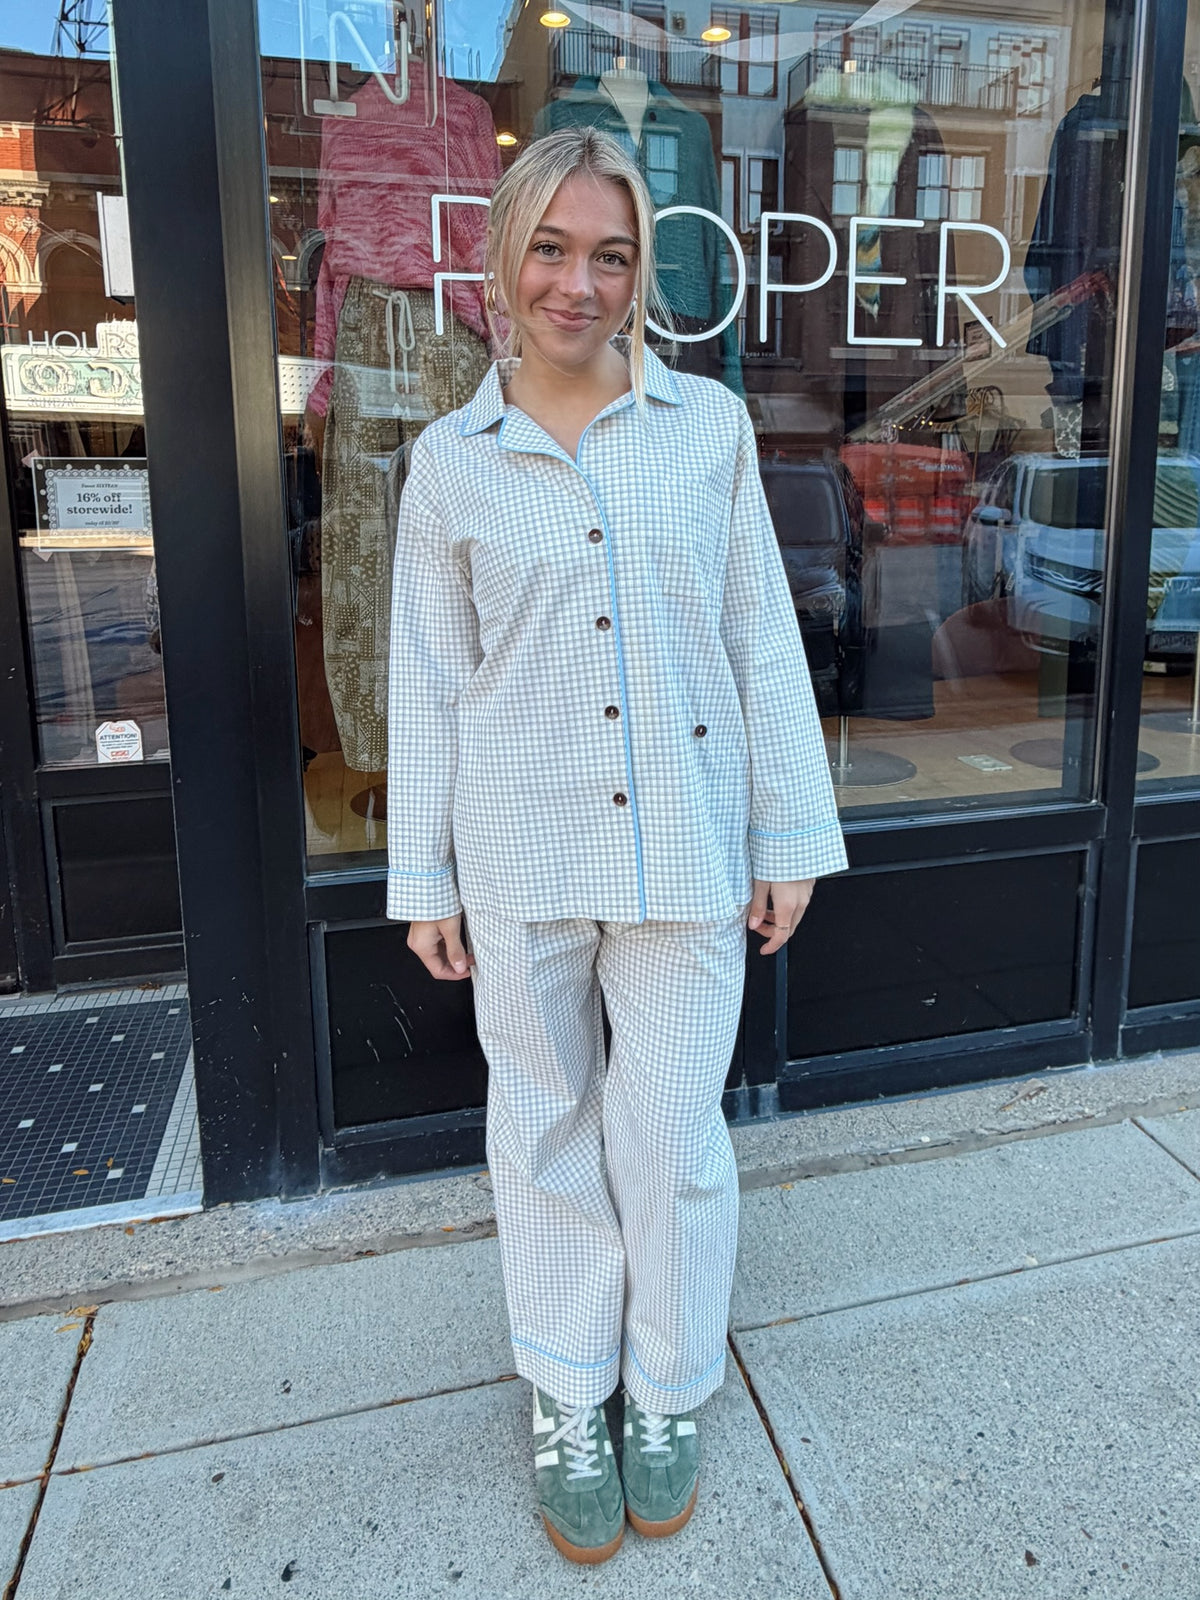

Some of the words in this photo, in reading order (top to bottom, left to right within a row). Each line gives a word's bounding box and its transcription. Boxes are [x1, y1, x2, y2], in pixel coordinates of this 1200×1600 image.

[76, 492, 101, 503] 16%
[103, 492, 122, 503] off
[66, 503, 133, 515] storewide!
[99, 733, 138, 741] ATTENTION!
